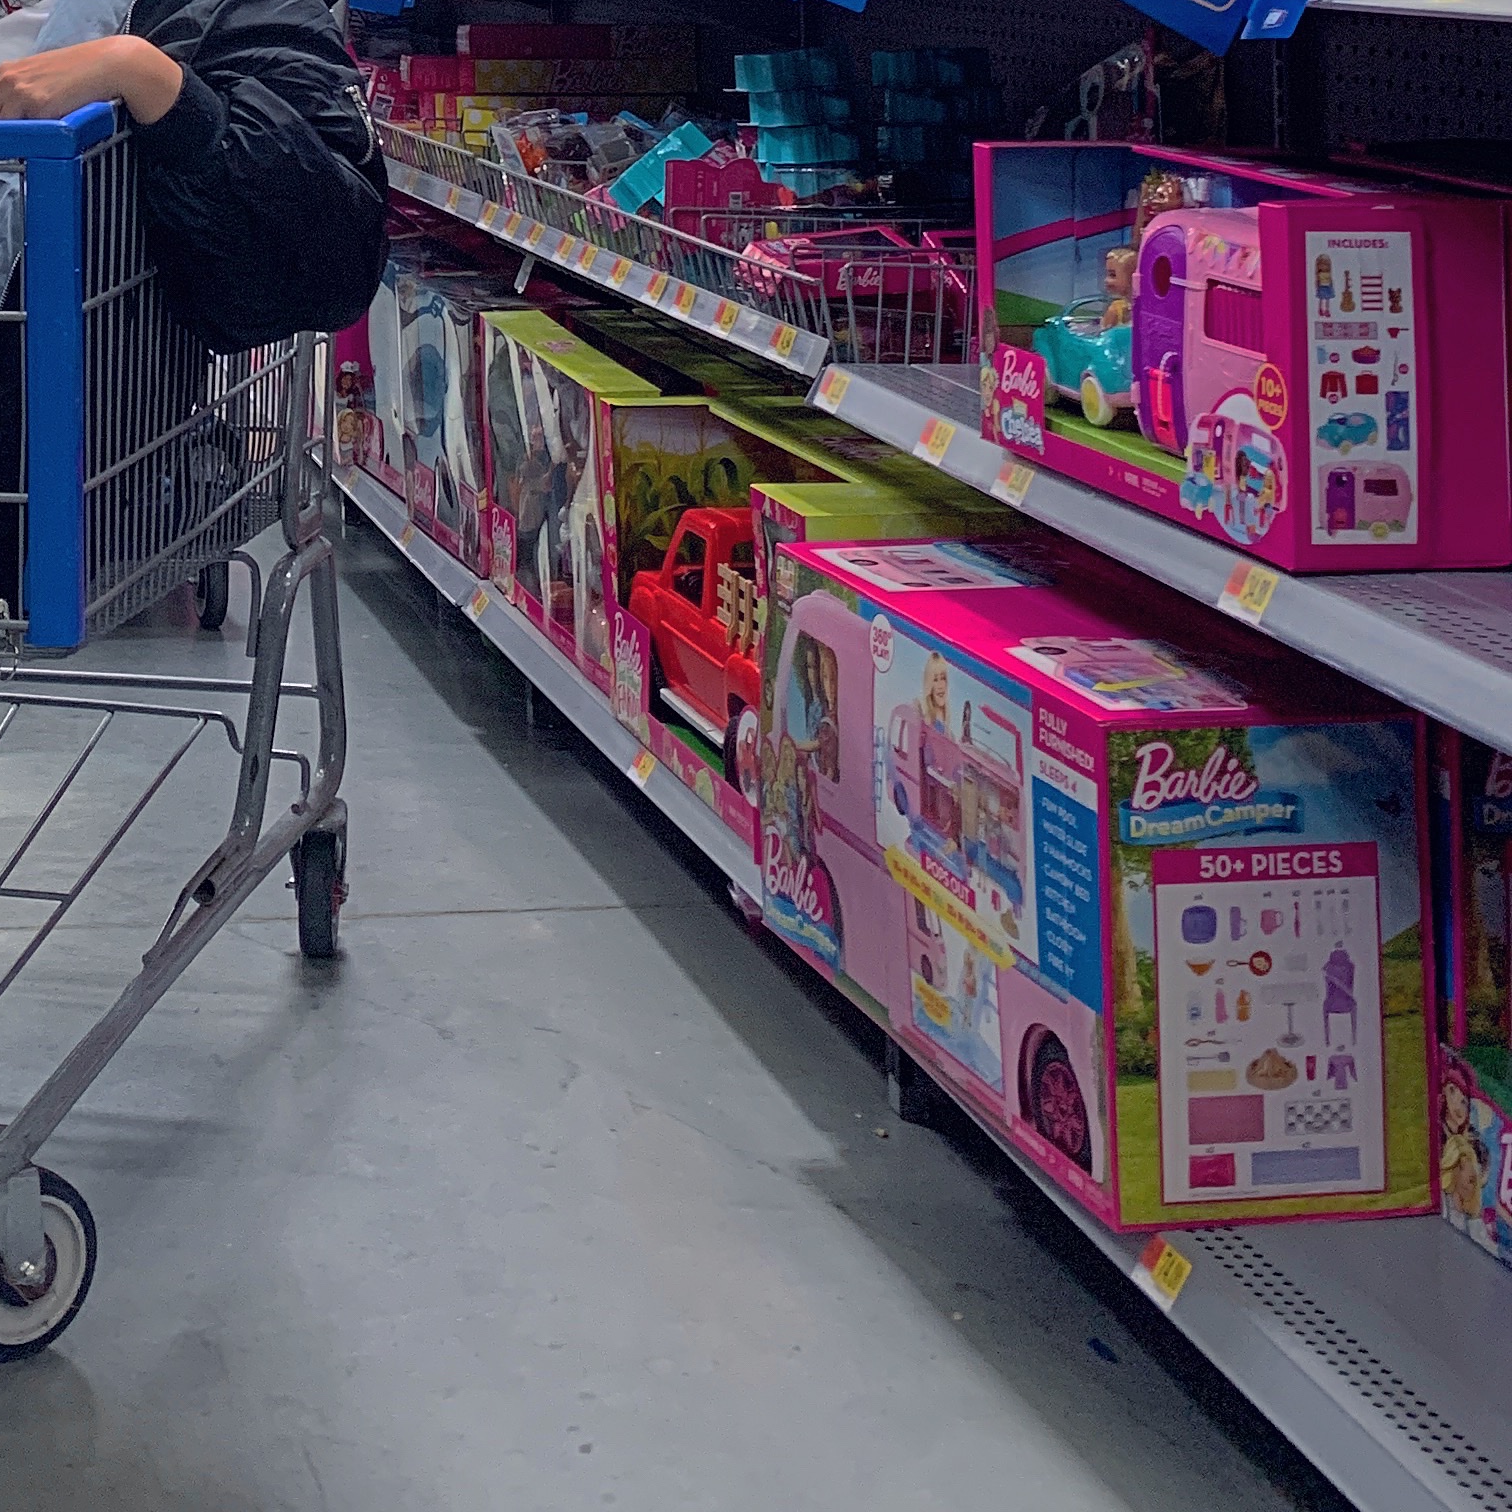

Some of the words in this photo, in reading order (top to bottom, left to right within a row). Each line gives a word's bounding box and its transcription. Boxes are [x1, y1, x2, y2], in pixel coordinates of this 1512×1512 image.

[1326, 237, 1389, 250] INCLUDES:
[1002, 350, 1041, 399] Barbie
[1259, 376, 1283, 396] 10+
[614, 611, 644, 676] Barbie
[1039, 706, 1069, 738] FULLY
[1038, 726, 1095, 773] FURNISHED!
[1038, 759, 1071, 790] SLEEPS
[1071, 781, 1079, 795] 4
[1132, 740, 1258, 811] Barbie
[764, 825, 824, 922] Barbie
[925, 856, 950, 889] POPS
[950, 874, 970, 902] OUT
[1199, 855, 1244, 879] 50+
[1251, 851, 1343, 877] PIECES
